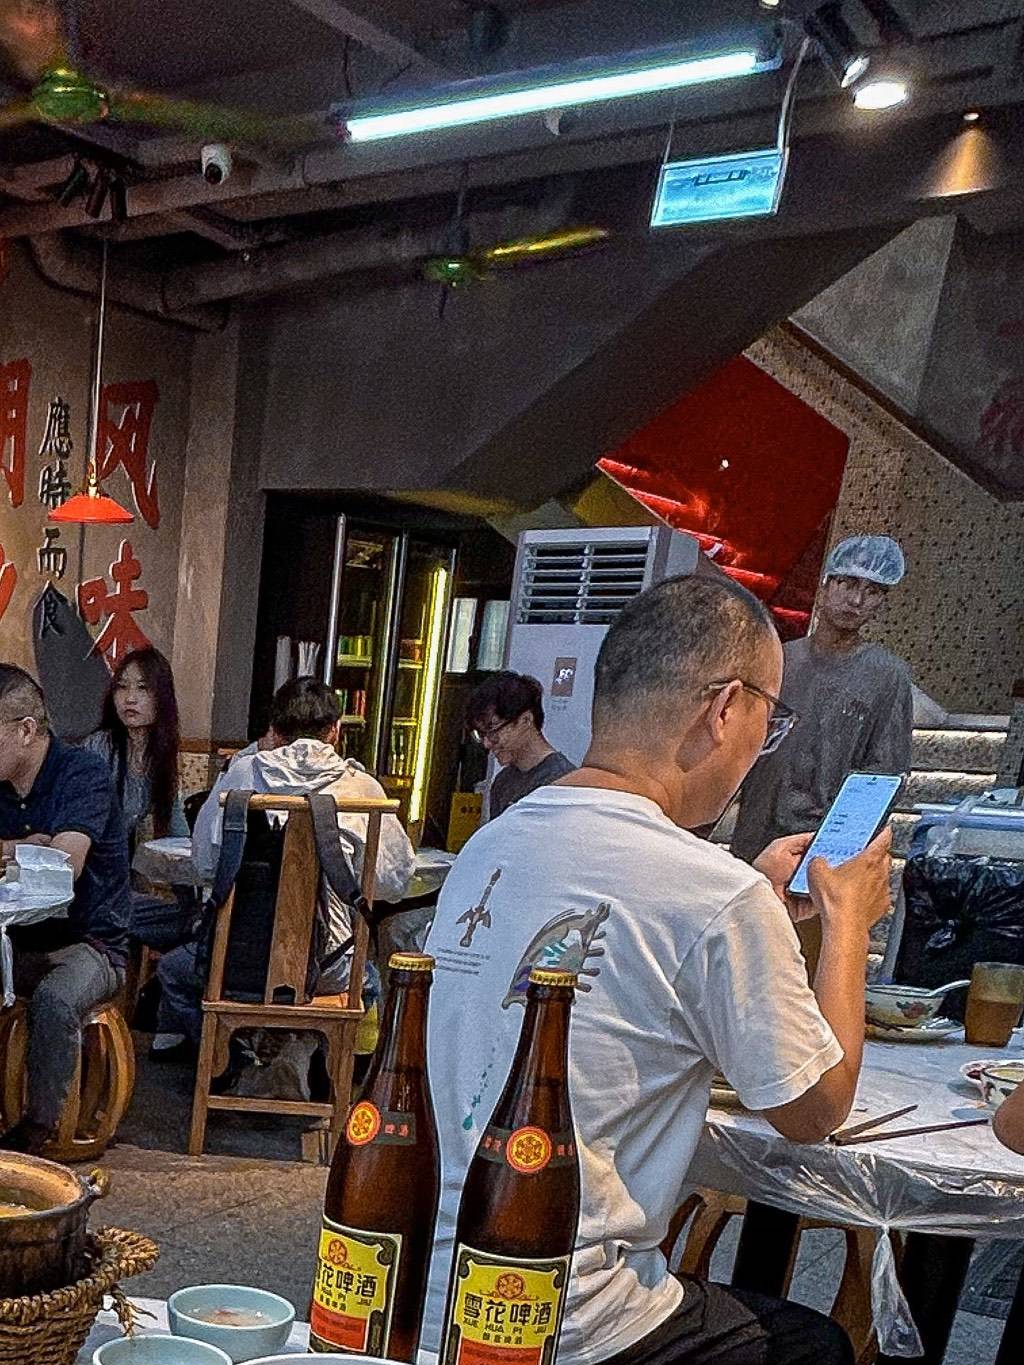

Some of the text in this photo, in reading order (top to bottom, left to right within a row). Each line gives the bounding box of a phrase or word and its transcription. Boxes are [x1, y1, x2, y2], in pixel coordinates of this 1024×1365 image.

[316, 1262, 379, 1298] 花啤酒
[463, 1292, 553, 1326] 雪花啤酒
